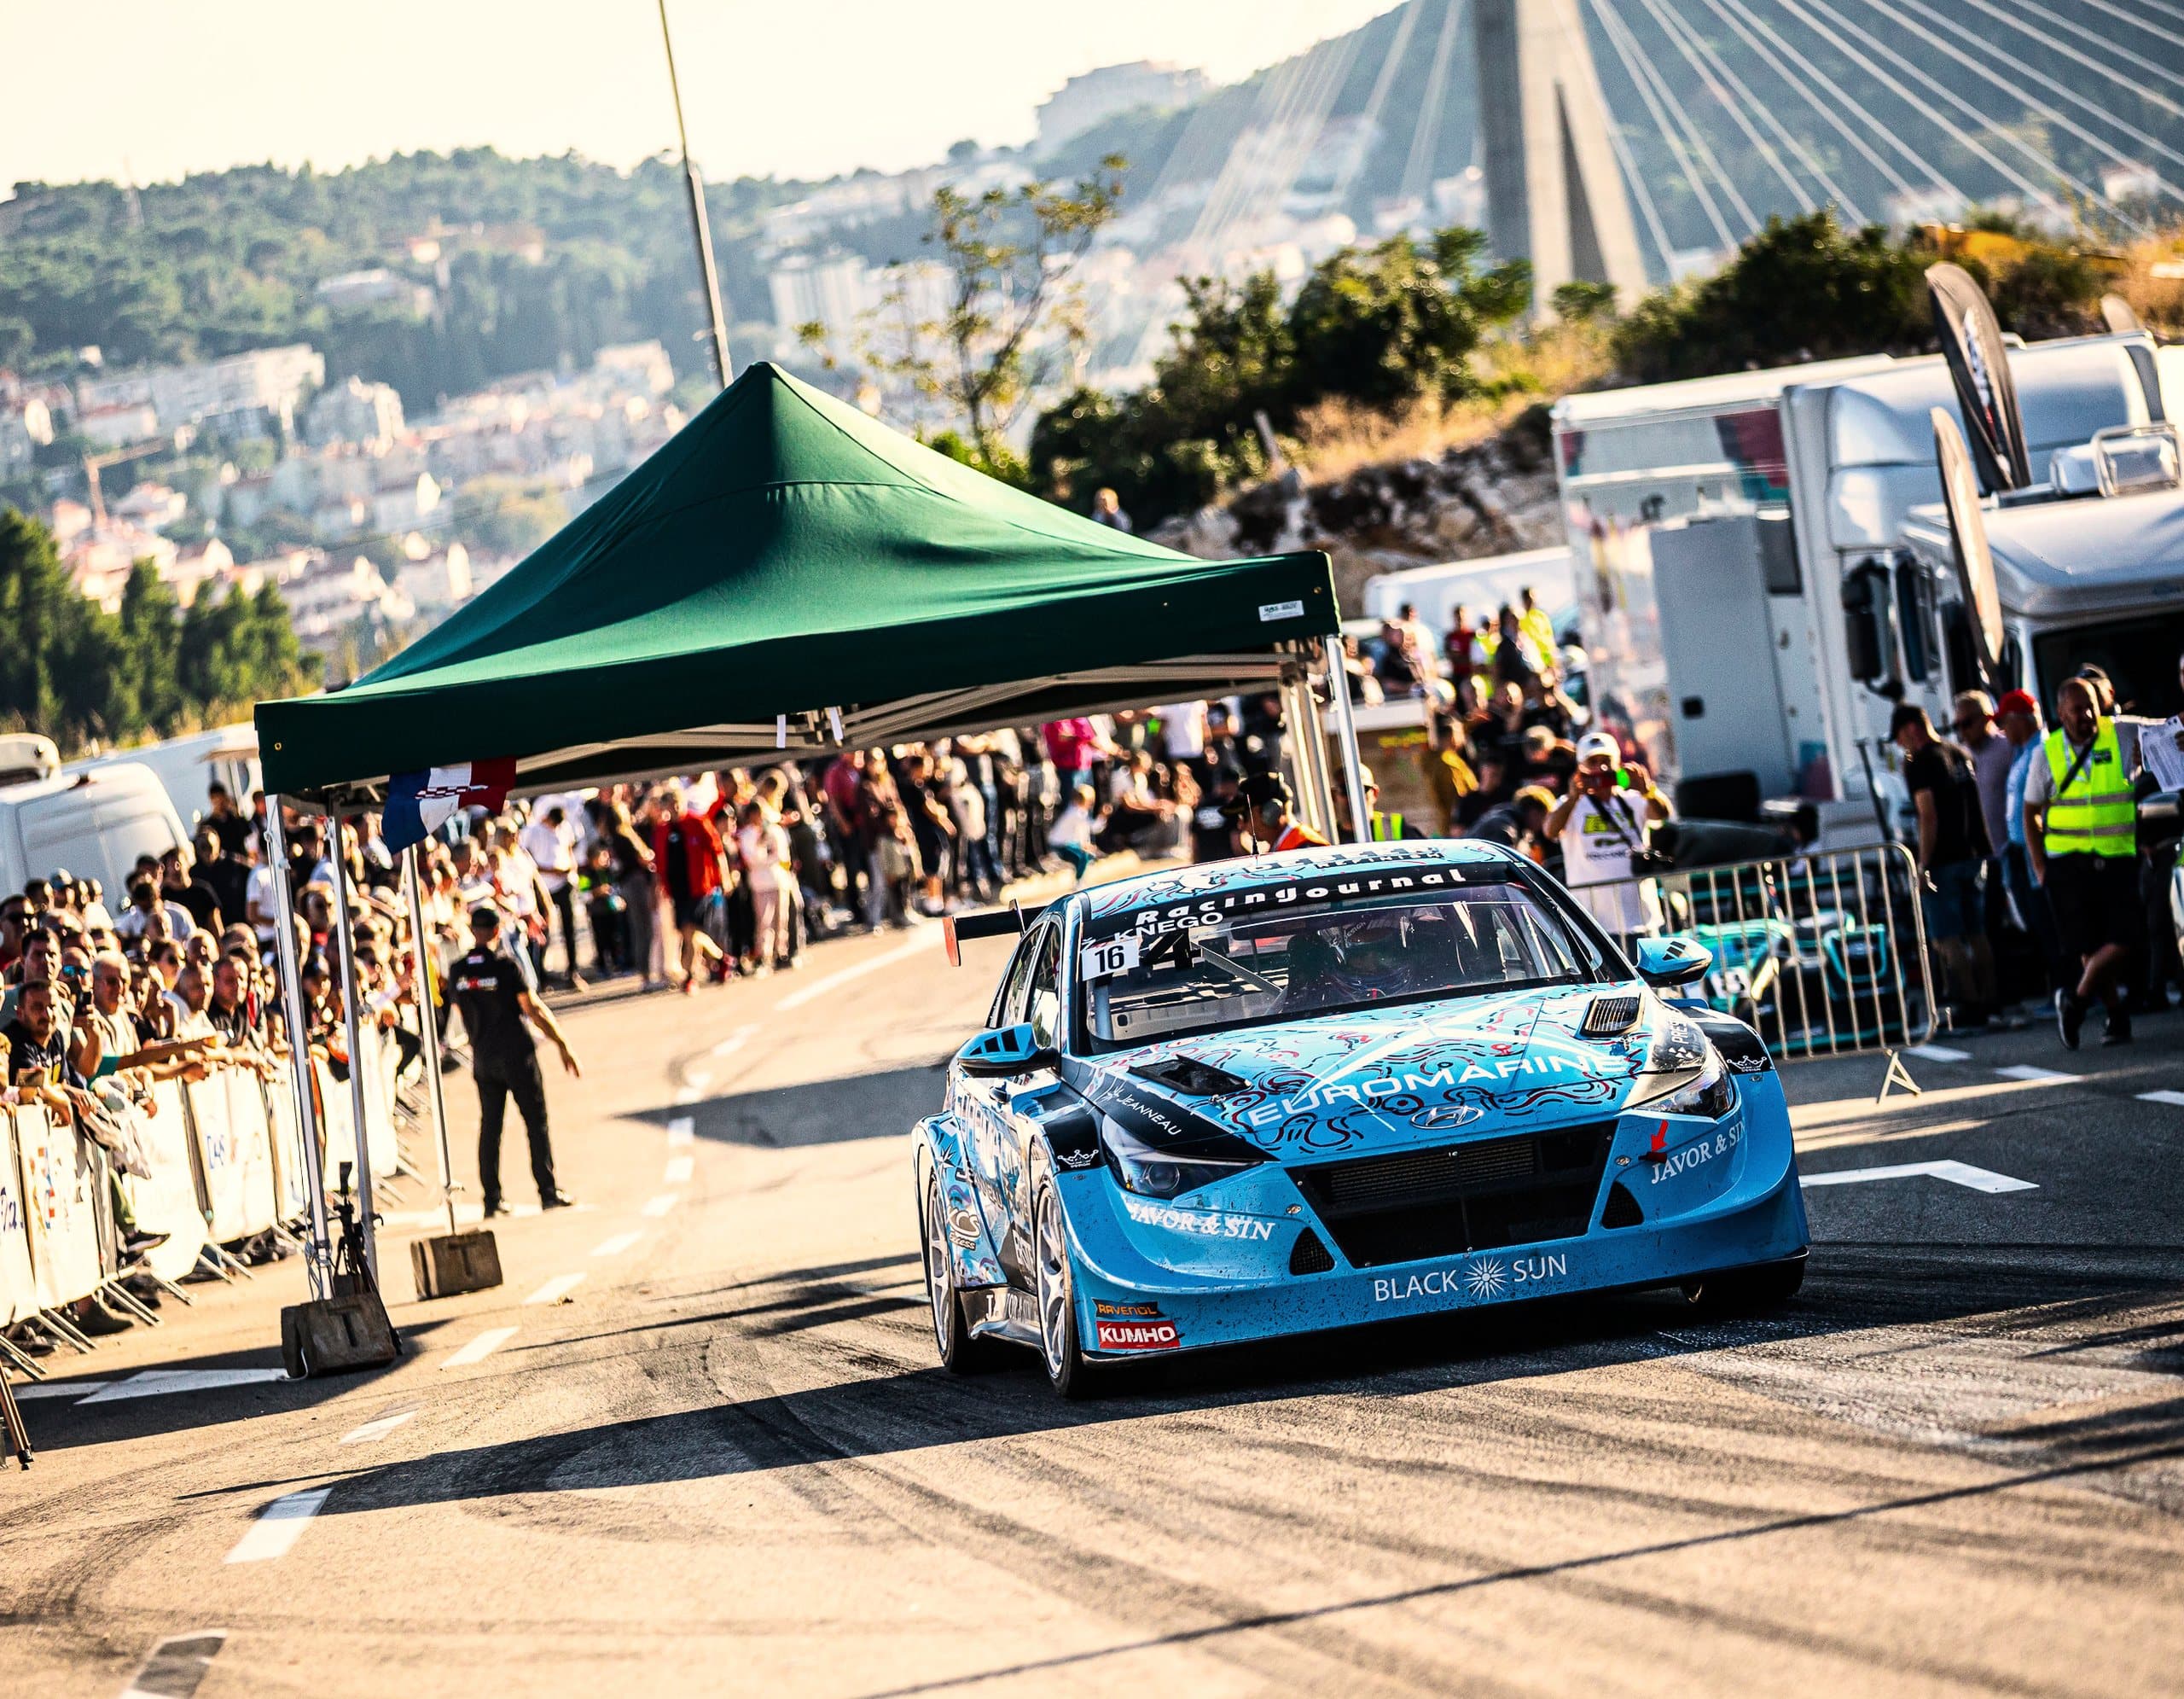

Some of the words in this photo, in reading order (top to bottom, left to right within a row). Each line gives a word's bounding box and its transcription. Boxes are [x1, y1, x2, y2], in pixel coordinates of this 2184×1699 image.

[1114, 911, 1223, 942] KNEGO
[1095, 945, 1124, 973] 16
[1248, 1055, 1627, 1126] EUROMARINE
[1116, 1094, 1182, 1135] JEANNEAU
[1651, 1142, 1712, 1184] JAVOR
[1715, 1134, 1728, 1155] &
[1130, 1202, 1195, 1232] JAVOR
[1200, 1213, 1222, 1235] &
[1224, 1214, 1276, 1241] SIN
[1374, 1269, 1459, 1301] BLACK
[1513, 1254, 1567, 1283] SUN
[1097, 1303, 1158, 1315] RAVENOL
[1099, 1326, 1176, 1343] KUMHO
